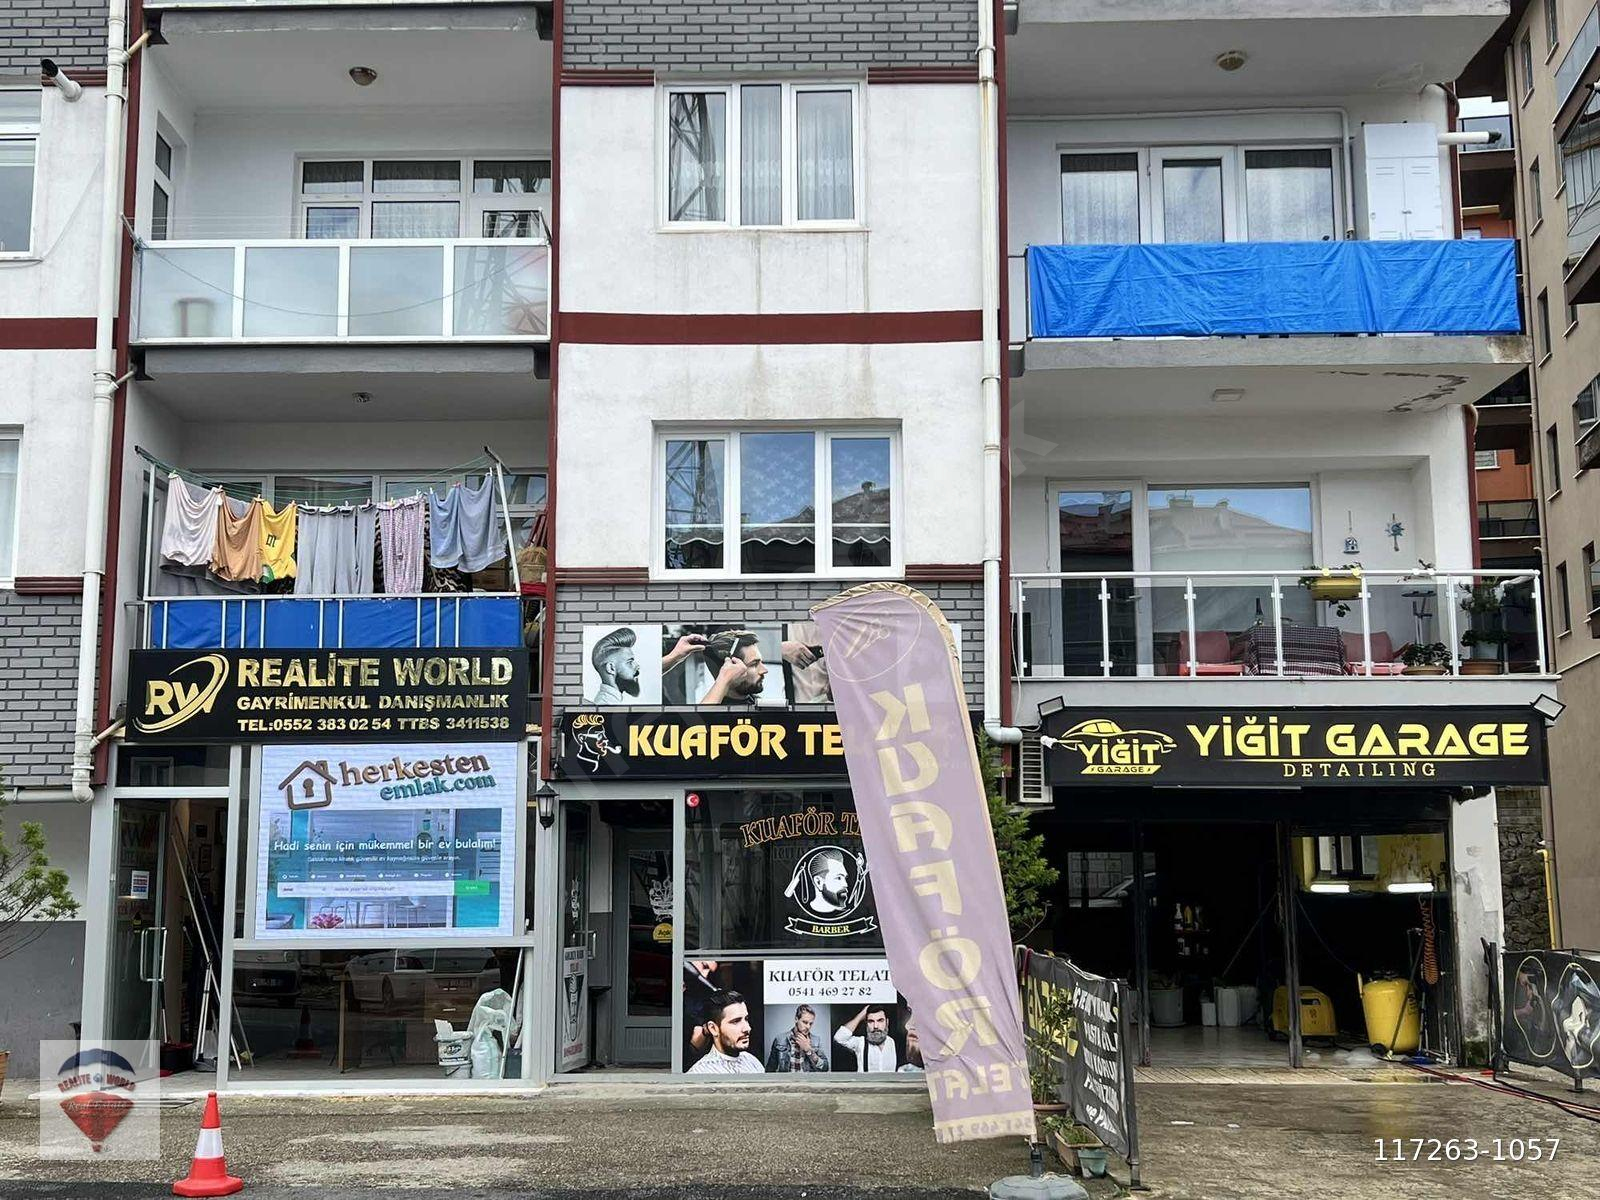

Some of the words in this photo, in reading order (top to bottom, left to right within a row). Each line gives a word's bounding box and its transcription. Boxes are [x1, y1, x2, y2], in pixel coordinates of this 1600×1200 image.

[237, 653, 380, 687] REALİTE
[393, 657, 513, 686] WORLD
[237, 692, 370, 710] GAYRİMENKUL
[379, 694, 510, 712] DANIŞMANLIK
[238, 718, 312, 731] TEL:0552
[317, 718, 346, 731] 383
[349, 718, 369, 731] 02
[372, 718, 392, 730] 54
[397, 717, 440, 730] TTBS
[446, 717, 510, 730] 3411538
[628, 718, 788, 761] KUAFÖR
[1186, 716, 1311, 757] YİĞİT
[1325, 723, 1530, 756] GARAGE
[1077, 738, 1161, 765] YİĞİT
[338, 754, 490, 787] herkesten
[1097, 765, 1145, 775] GARAGE
[1283, 762, 1437, 778] DETAILING
[380, 773, 497, 801] emlak.com
[274, 841, 299, 852] Hadi
[304, 841, 331, 852] senin
[335, 840, 355, 853] için
[358, 838, 414, 851] mükemmel
[418, 838, 434, 850] bir
[438, 840, 451, 850] ev
[455, 838, 496, 851] bulalım!
[811, 924, 851, 935] BARBER
[769, 967, 834, 983] KUAFÖR
[839, 968, 891, 983] TELAT
[788, 987, 815, 998] 0541
[819, 987, 839, 998] 469
[842, 986, 856, 997] 27
[858, 986, 873, 997] 82
